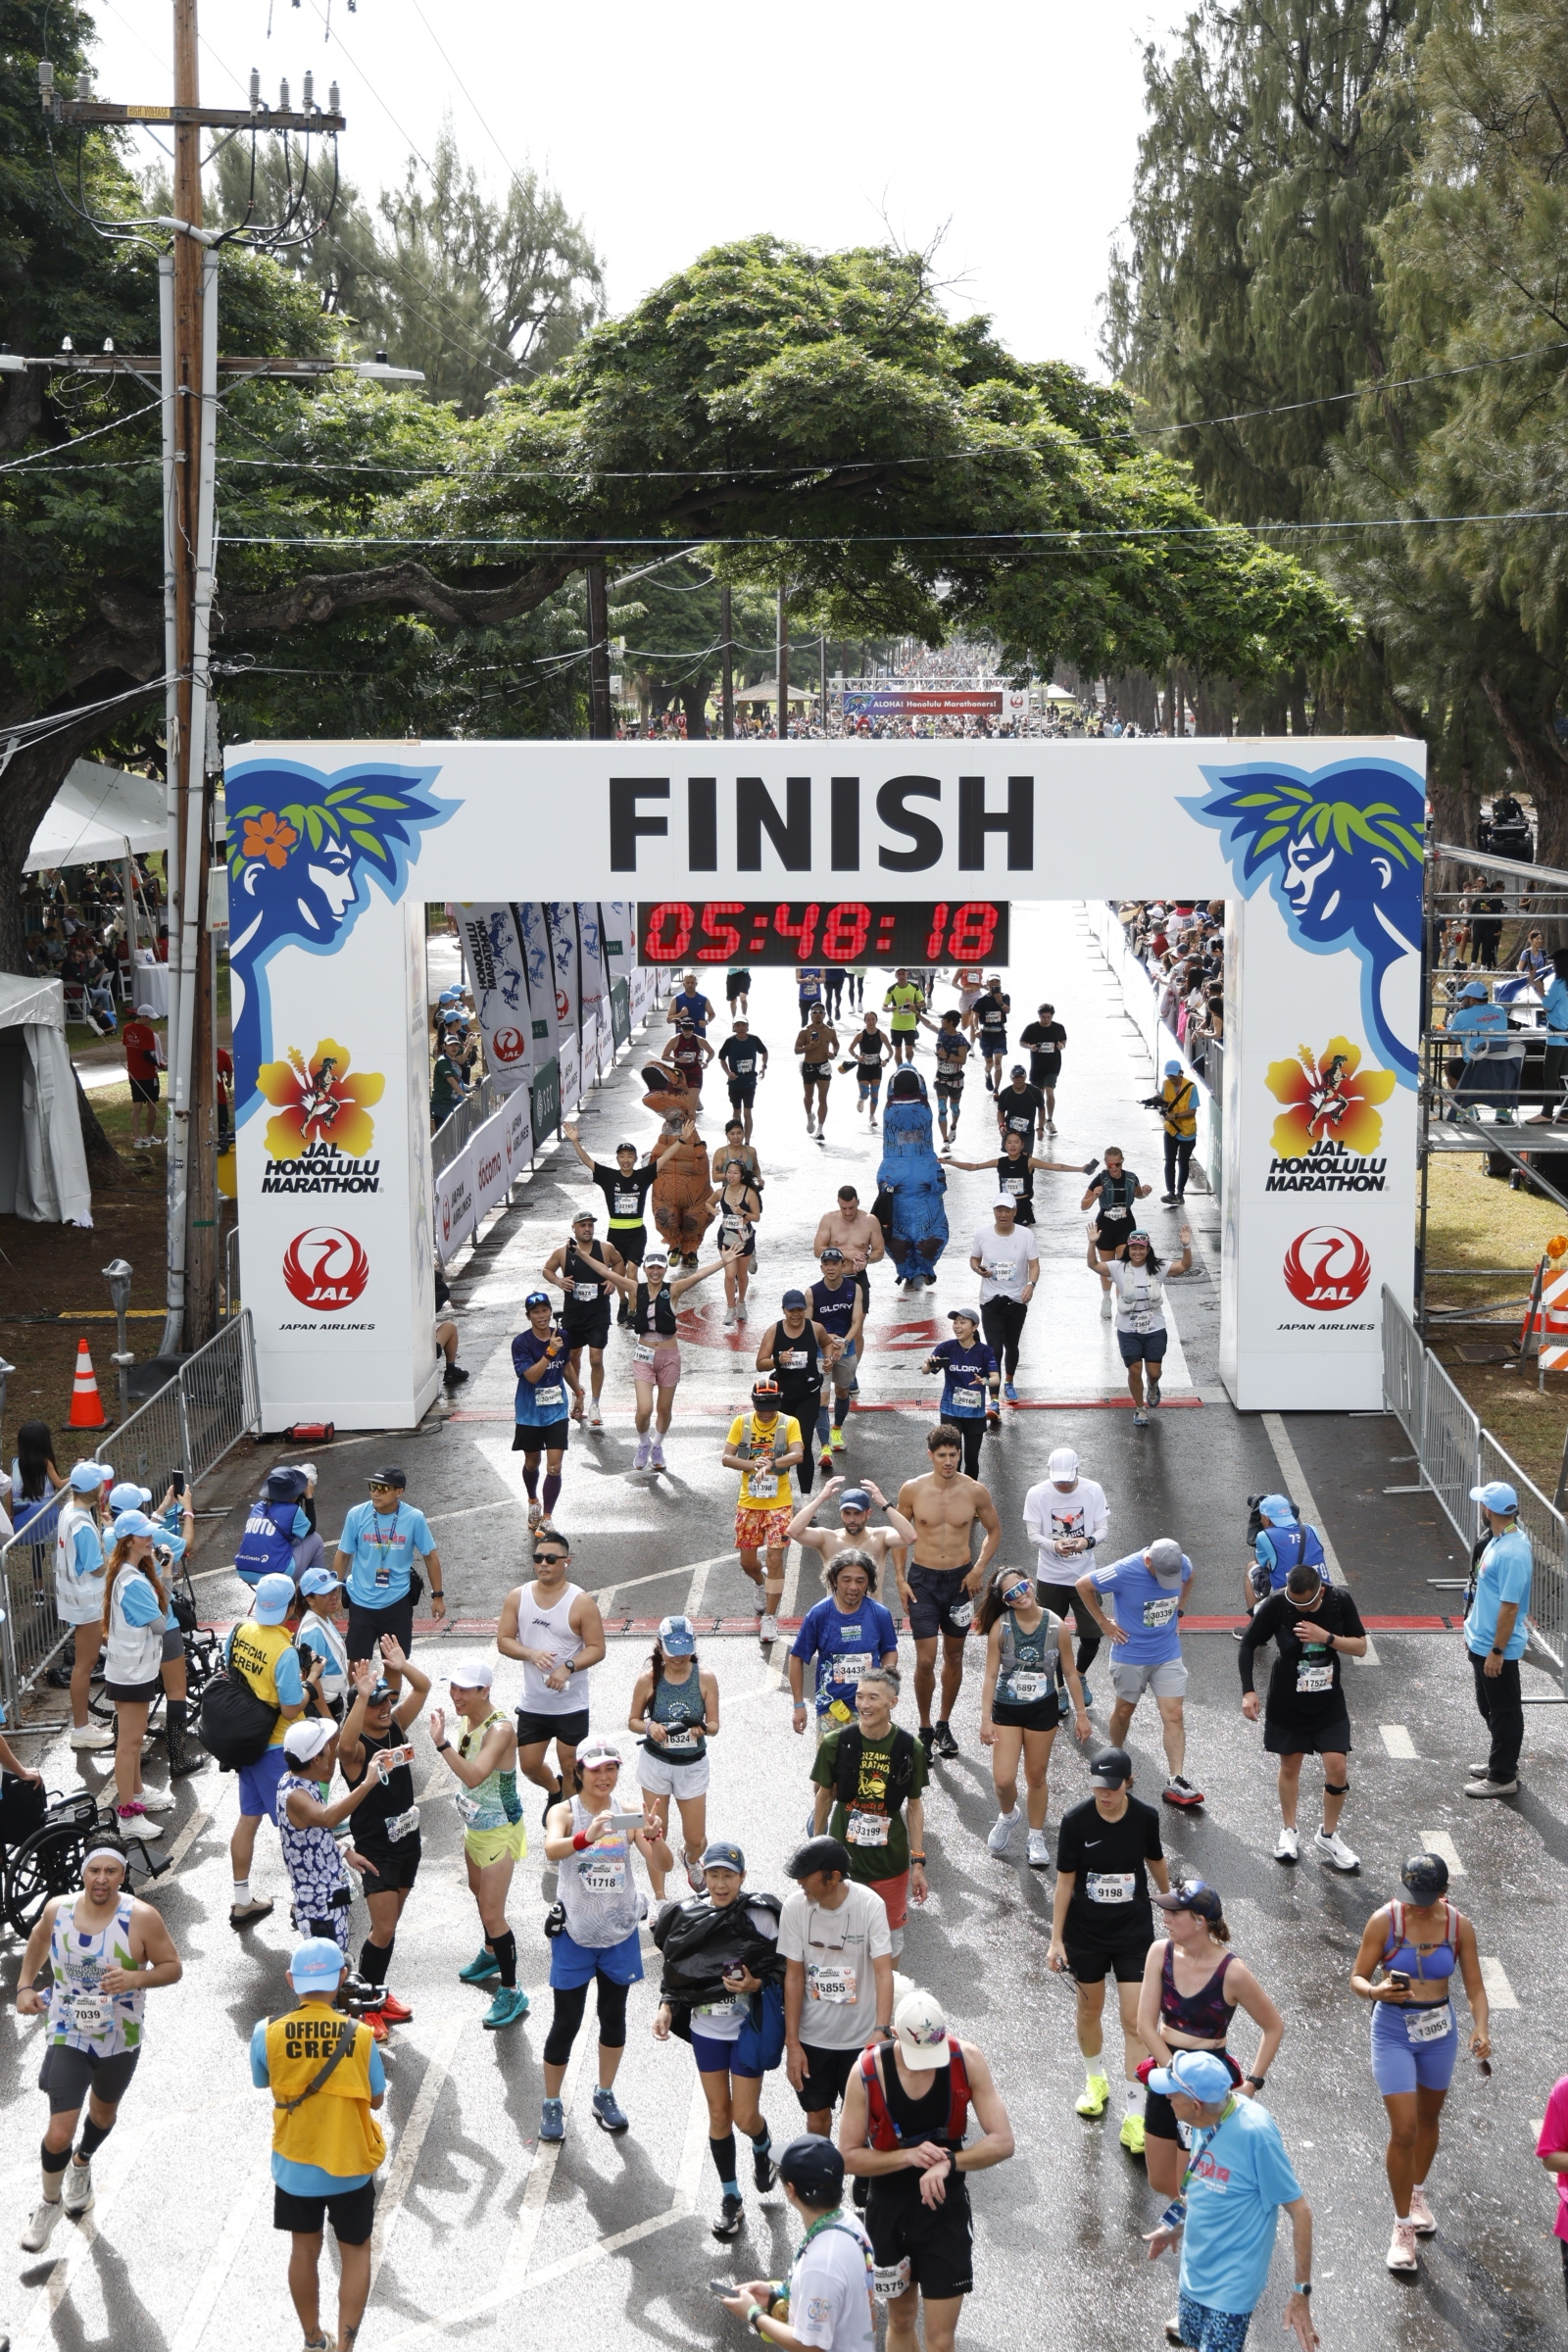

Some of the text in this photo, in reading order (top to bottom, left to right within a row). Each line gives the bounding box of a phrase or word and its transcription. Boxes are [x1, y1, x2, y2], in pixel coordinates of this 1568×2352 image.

[610, 775, 1034, 872] FINISH
[645, 903, 999, 960] 05:48:18
[466, 922, 487, 991] HONOLULU
[476, 920, 498, 991] MARATHON
[503, 1050, 520, 1059] JAL
[302, 1143, 342, 1158] JAL
[1307, 1141, 1348, 1156] JAL
[265, 1160, 380, 1176] HONOLULU
[478, 1152, 502, 1192] docomo
[1269, 1158, 1387, 1174] HONOLULU
[262, 1178, 380, 1194] MARATHON
[1265, 1176, 1386, 1192] MARATHON
[452, 1180, 465, 1208] JAPAN
[453, 1193, 471, 1229] AIRLINES
[307, 1287, 353, 1301] JAL
[1305, 1287, 1353, 1300] JAL
[819, 1303, 853, 1314] GLORY
[949, 1364, 983, 1373] GLORY
[1151, 1608, 1173, 1620] 30339
[232, 1638, 268, 1665] OFFICIAL
[233, 1651, 264, 1676] CREW
[840, 1666, 866, 1675] 34438
[1016, 1684, 1037, 1692] 6897
[1304, 1679, 1328, 1688] 17522
[856, 1825, 881, 1837] 33199
[1098, 1887, 1123, 1897] 9198
[815, 1982, 846, 1993] 15855
[74, 2010, 101, 2020] 7039
[285, 2021, 356, 2039] OFFICIA
